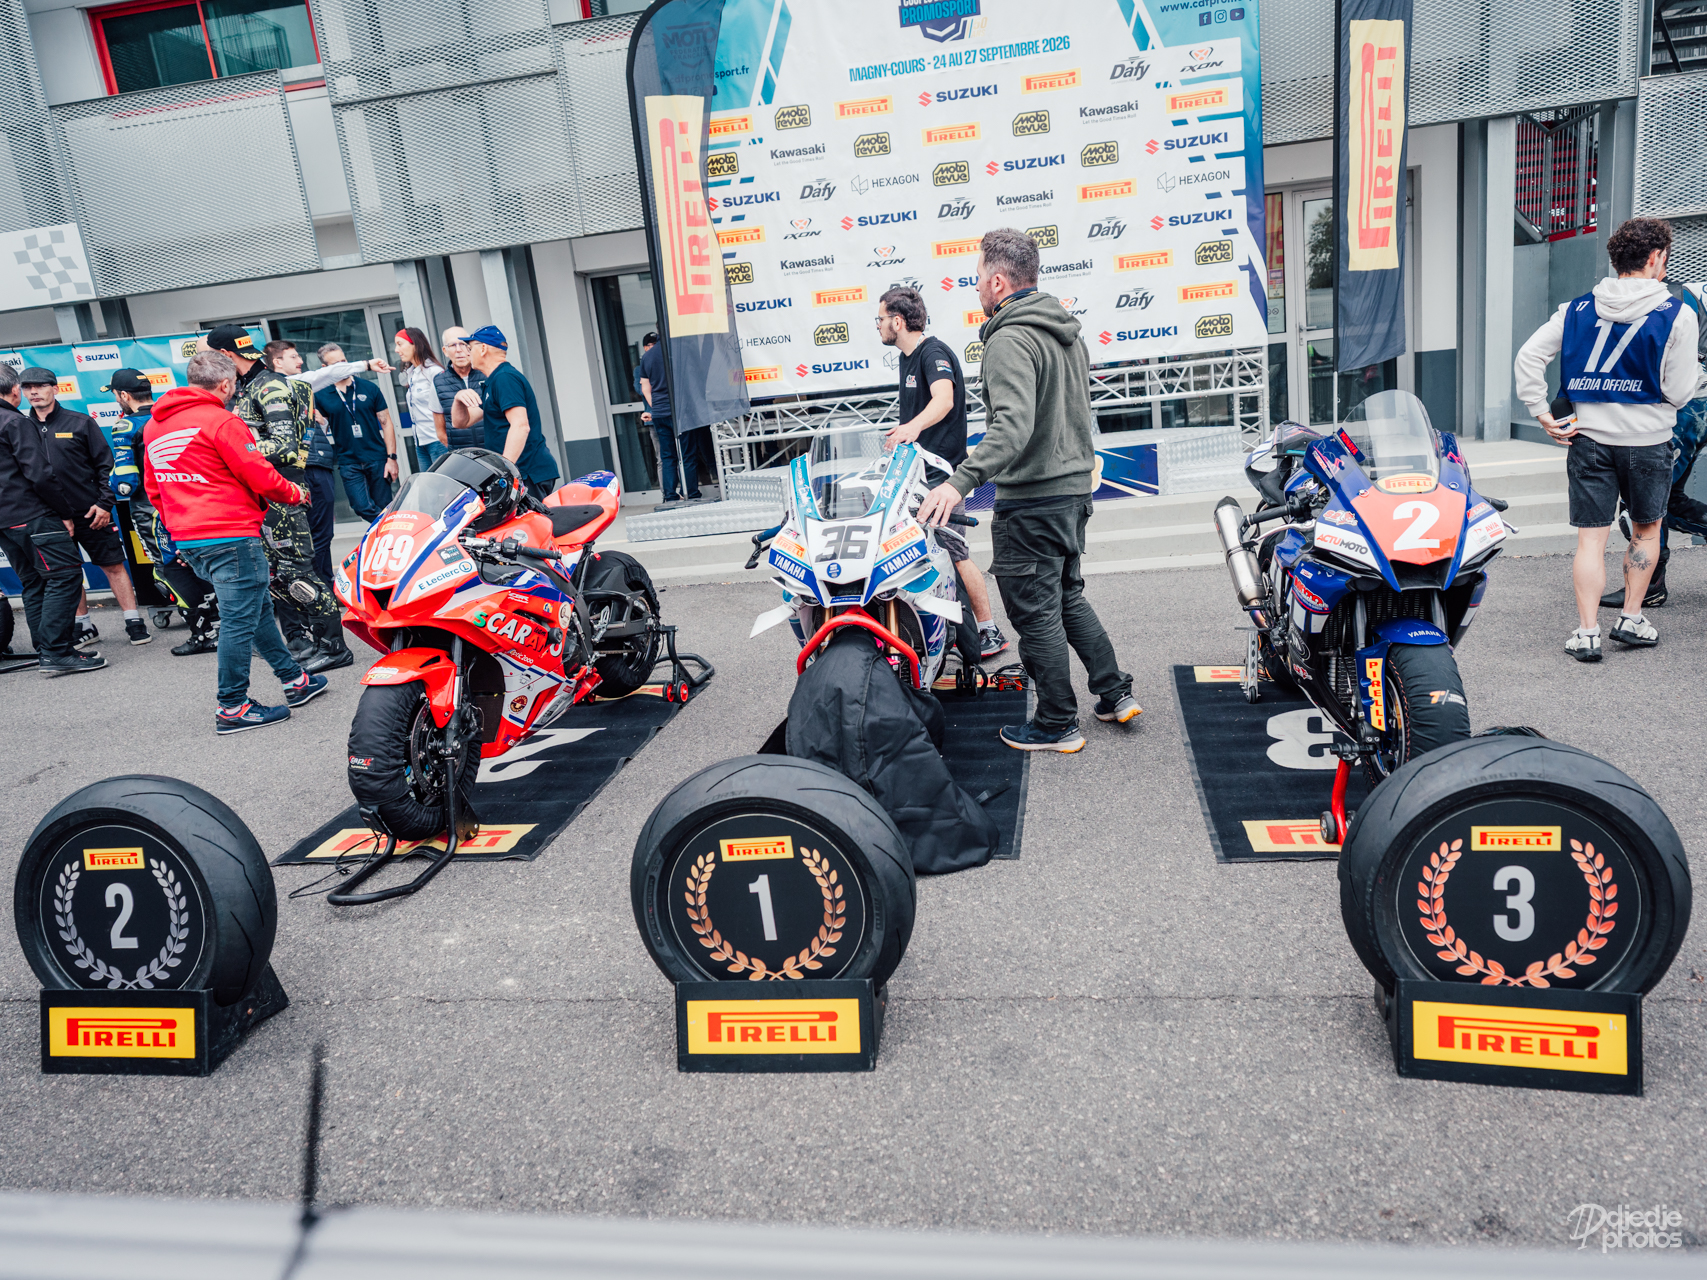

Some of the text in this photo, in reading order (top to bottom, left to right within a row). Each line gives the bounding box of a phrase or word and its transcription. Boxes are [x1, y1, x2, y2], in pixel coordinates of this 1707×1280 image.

[901, 0, 978, 25] PROMOSPORT
[849, 58, 925, 82] MAGNY-COURS
[933, 54, 946, 70] 24
[949, 52, 963, 67] AU
[965, 50, 977, 64] 27
[980, 40, 1041, 63] SEPTEMBRE
[1042, 35, 1071, 53] 2026
[1110, 60, 1150, 81] Dafy
[1025, 71, 1077, 91] PIRELLI
[936, 85, 998, 102] SUZUKI
[1171, 90, 1223, 110] PIRELLI
[839, 98, 888, 116] PIRELLI
[1080, 99, 1139, 117] Kawasaki
[926, 125, 976, 143] PIRELLI
[1164, 132, 1228, 150] SUZUKI
[770, 143, 826, 160] Kawasaki
[1004, 154, 1065, 172] SUZUKI
[872, 173, 919, 188] HEXAGON
[1179, 170, 1230, 185] HEXAGON
[722, 191, 780, 207] SUZUKI
[800, 183, 836, 200] Dafy
[996, 189, 1054, 206] Kawasaki
[1082, 182, 1132, 199] PIRELLI
[858, 210, 917, 227] SUZUKI
[938, 202, 976, 219] Dafy
[1168, 209, 1232, 226] SUZUKI
[1088, 220, 1126, 240] Dafy
[935, 239, 982, 256] PIRELL
[780, 255, 835, 270] Kawasaki
[1038, 259, 1093, 275] Kawasaki
[1119, 252, 1168, 269] PIRELLI
[816, 288, 863, 304] PIRELLI
[1182, 284, 1233, 300] PIRELLI
[736, 298, 792, 312] SUZUKI
[1116, 292, 1154, 310] Dafy
[1575, 300, 1590, 312] 17
[746, 335, 791, 347] HEXAGON
[1116, 326, 1178, 340] SUZUKI
[1583, 315, 1649, 374] 17
[85, 353, 119, 361] SUZUKI
[812, 359, 869, 374] SUZUKI
[1567, 376, 1644, 392] MÉDIA OFFICIEL
[154, 472, 209, 483] ONDA
[1385, 476, 1433, 490] PIRELLI
[385, 513, 419, 521] HONDA
[889, 518, 909, 536] GRT
[1393, 500, 1440, 552] 2
[773, 536, 806, 559] PIRELLI
[815, 525, 873, 563] 36
[882, 525, 920, 553] PIRELLI
[1316, 533, 1369, 555] ACTUMOTO
[363, 533, 415, 572] 189
[881, 546, 922, 576] YAMAHA
[772, 553, 807, 581] YAMAHA
[1408, 628, 1442, 640] YAMAHA
[1368, 661, 1383, 727] PIRELLI
[1480, 831, 1553, 846] PIRELLI
[727, 840, 786, 857] PIRELLI
[89, 852, 139, 866] PIRELLI
[748, 873, 778, 941] 1
[1493, 864, 1536, 942] 3
[104, 882, 139, 949] 2
[66, 1017, 178, 1048] PIRELLI
[707, 1010, 839, 1043] PIRELLI
[1438, 1014, 1601, 1061] PIRELLI
